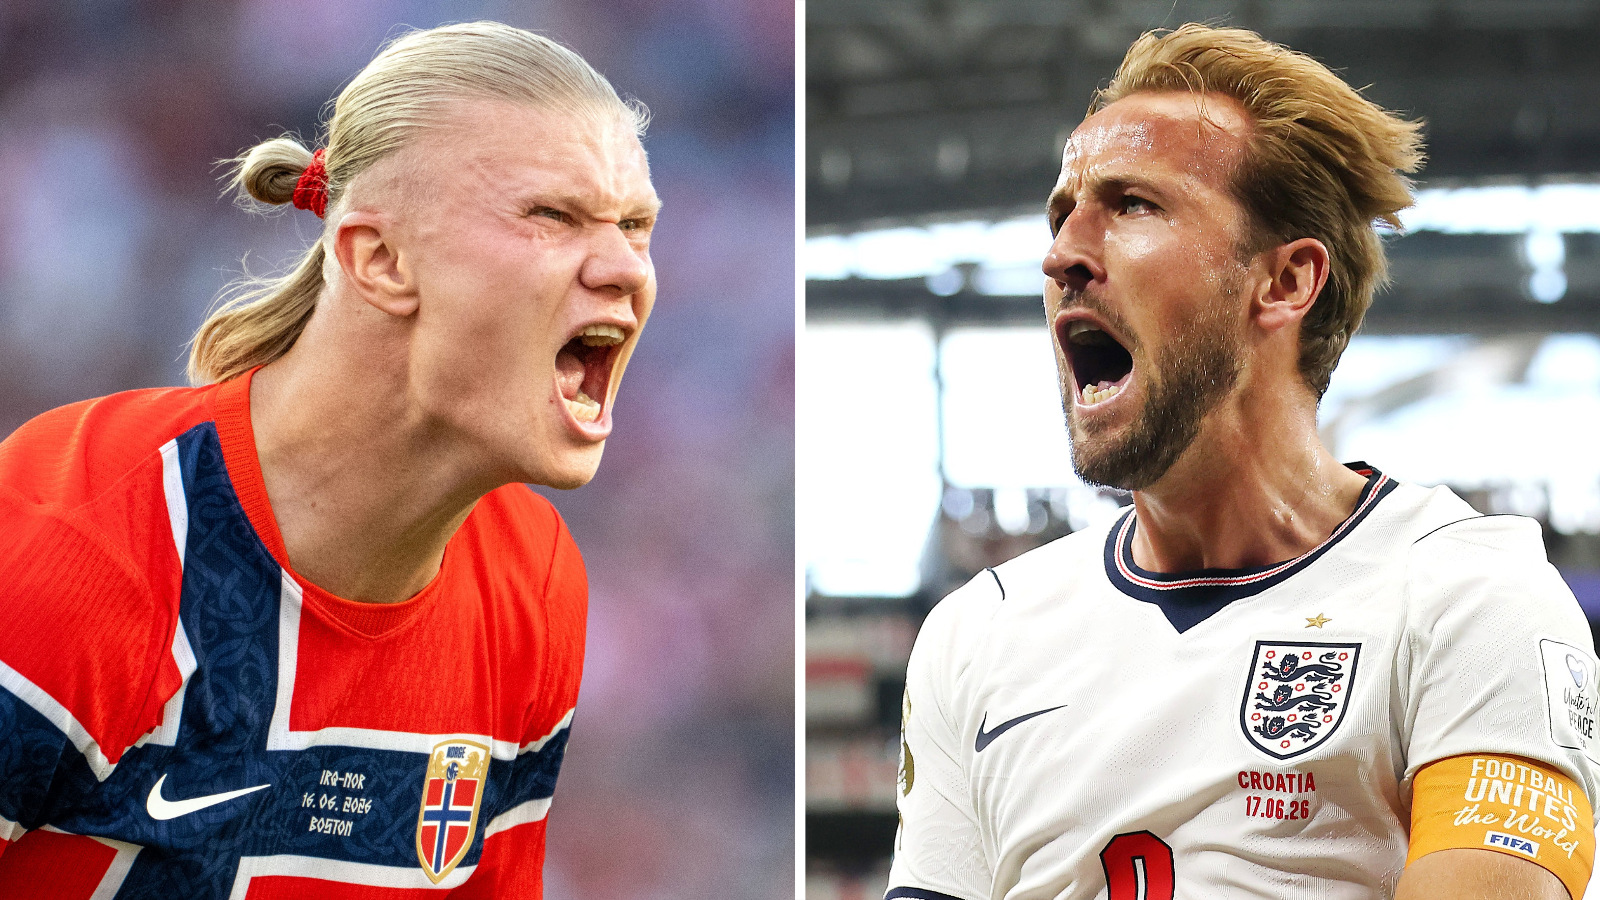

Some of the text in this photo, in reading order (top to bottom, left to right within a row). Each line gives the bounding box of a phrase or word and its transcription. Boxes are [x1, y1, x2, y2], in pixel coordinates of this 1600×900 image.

[1568, 709, 1594, 739] PEACE
[446, 746, 466, 758] NORGE
[319, 769, 366, 790] IRQ-NOR
[1237, 770, 1316, 793] CROATIA
[1471, 758, 1577, 810] FOOTBALL
[1245, 795, 1310, 820] 17.06.26
[1464, 777, 1578, 832] UNITES
[308, 815, 354, 837] BOSTON
[1453, 803, 1579, 859] the World
[1490, 834, 1534, 855] FIFA
